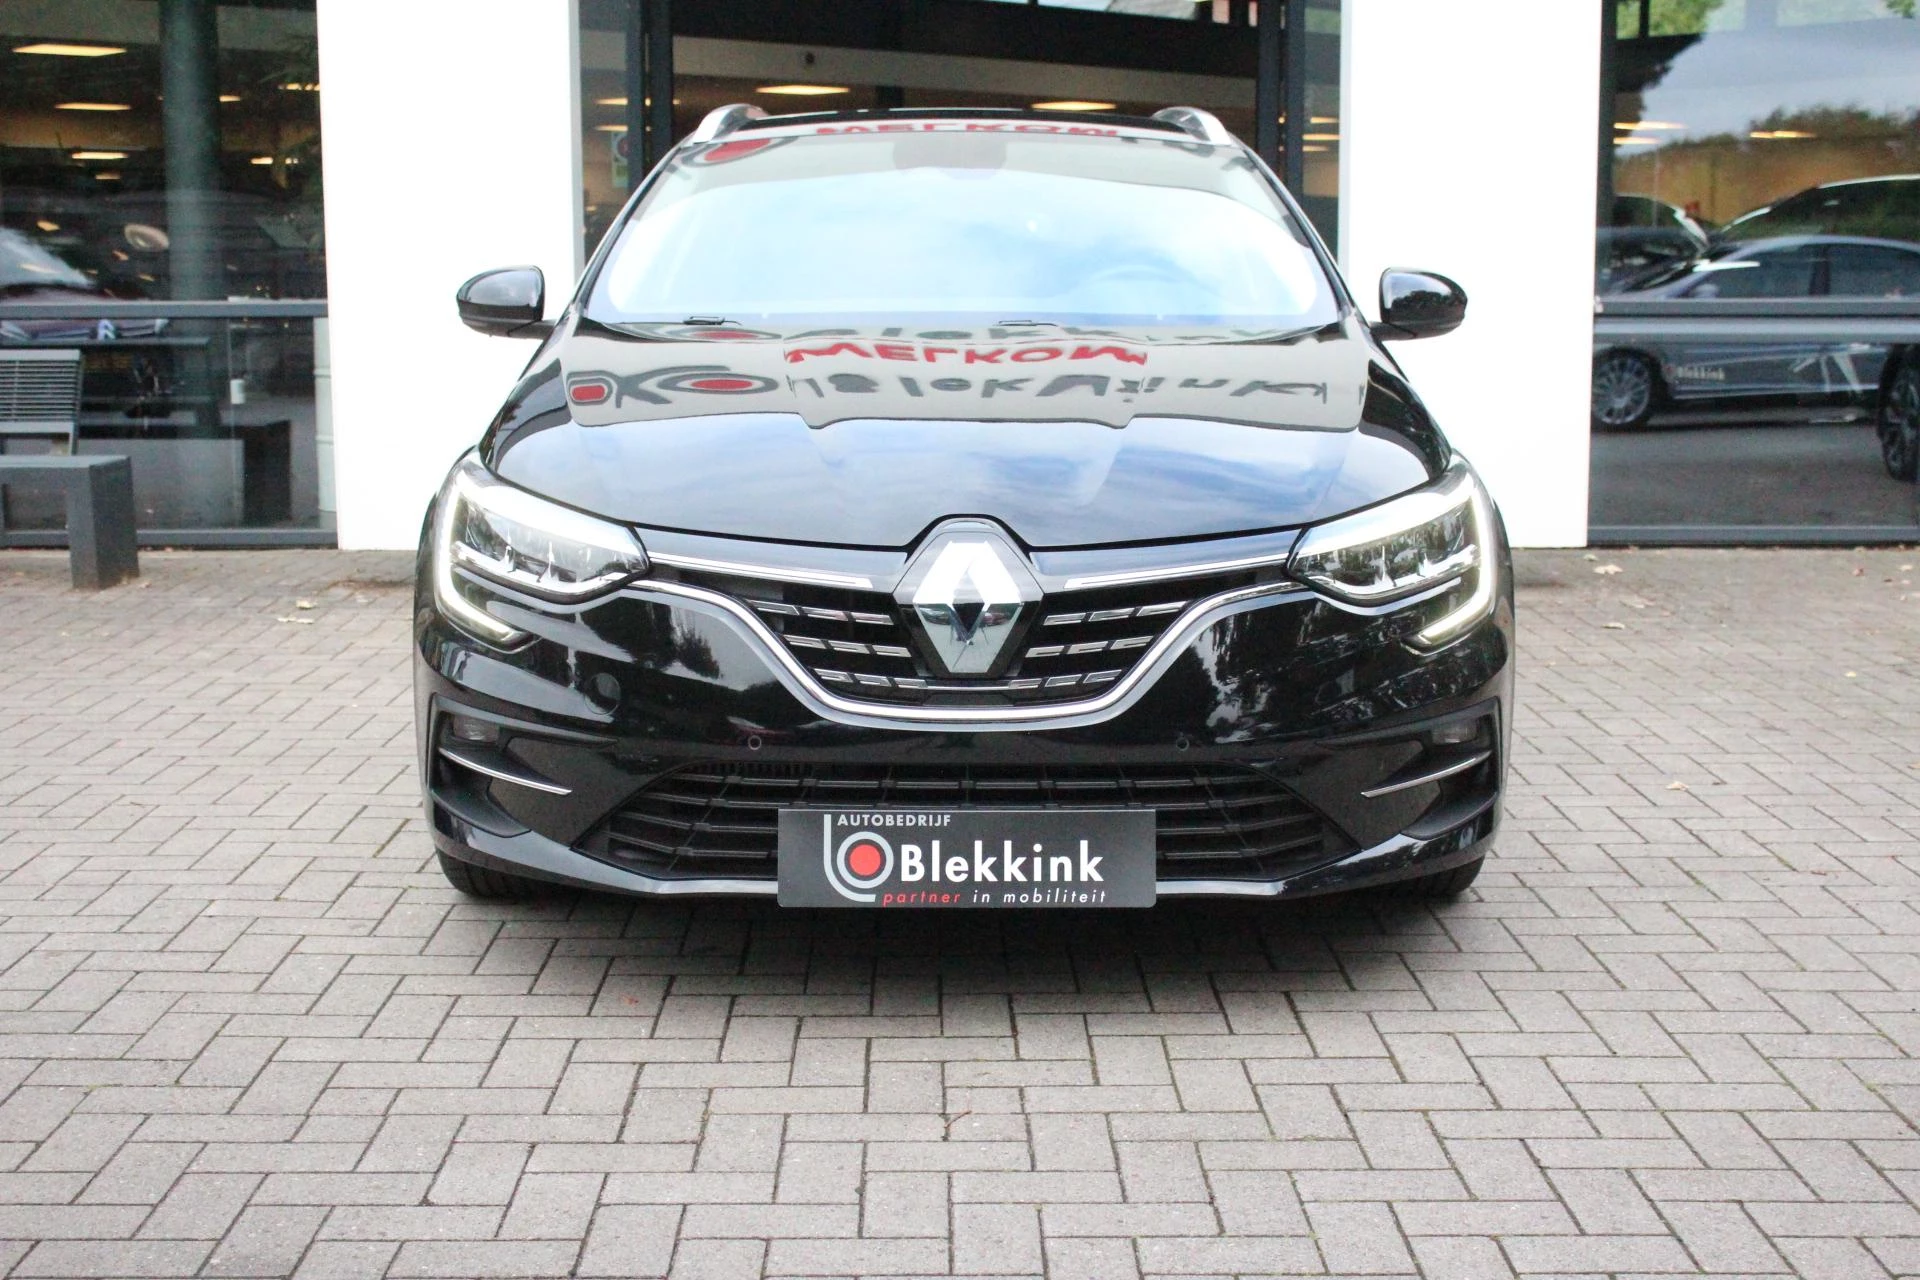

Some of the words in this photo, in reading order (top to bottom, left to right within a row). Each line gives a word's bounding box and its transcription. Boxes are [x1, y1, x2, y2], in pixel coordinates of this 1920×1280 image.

[837, 814, 951, 827] AUTOBEDRIJF
[900, 839, 1105, 883] Blekkink
[882, 890, 961, 907] partner
[973, 889, 991, 904] in
[1003, 887, 1106, 904] mobiliteit
